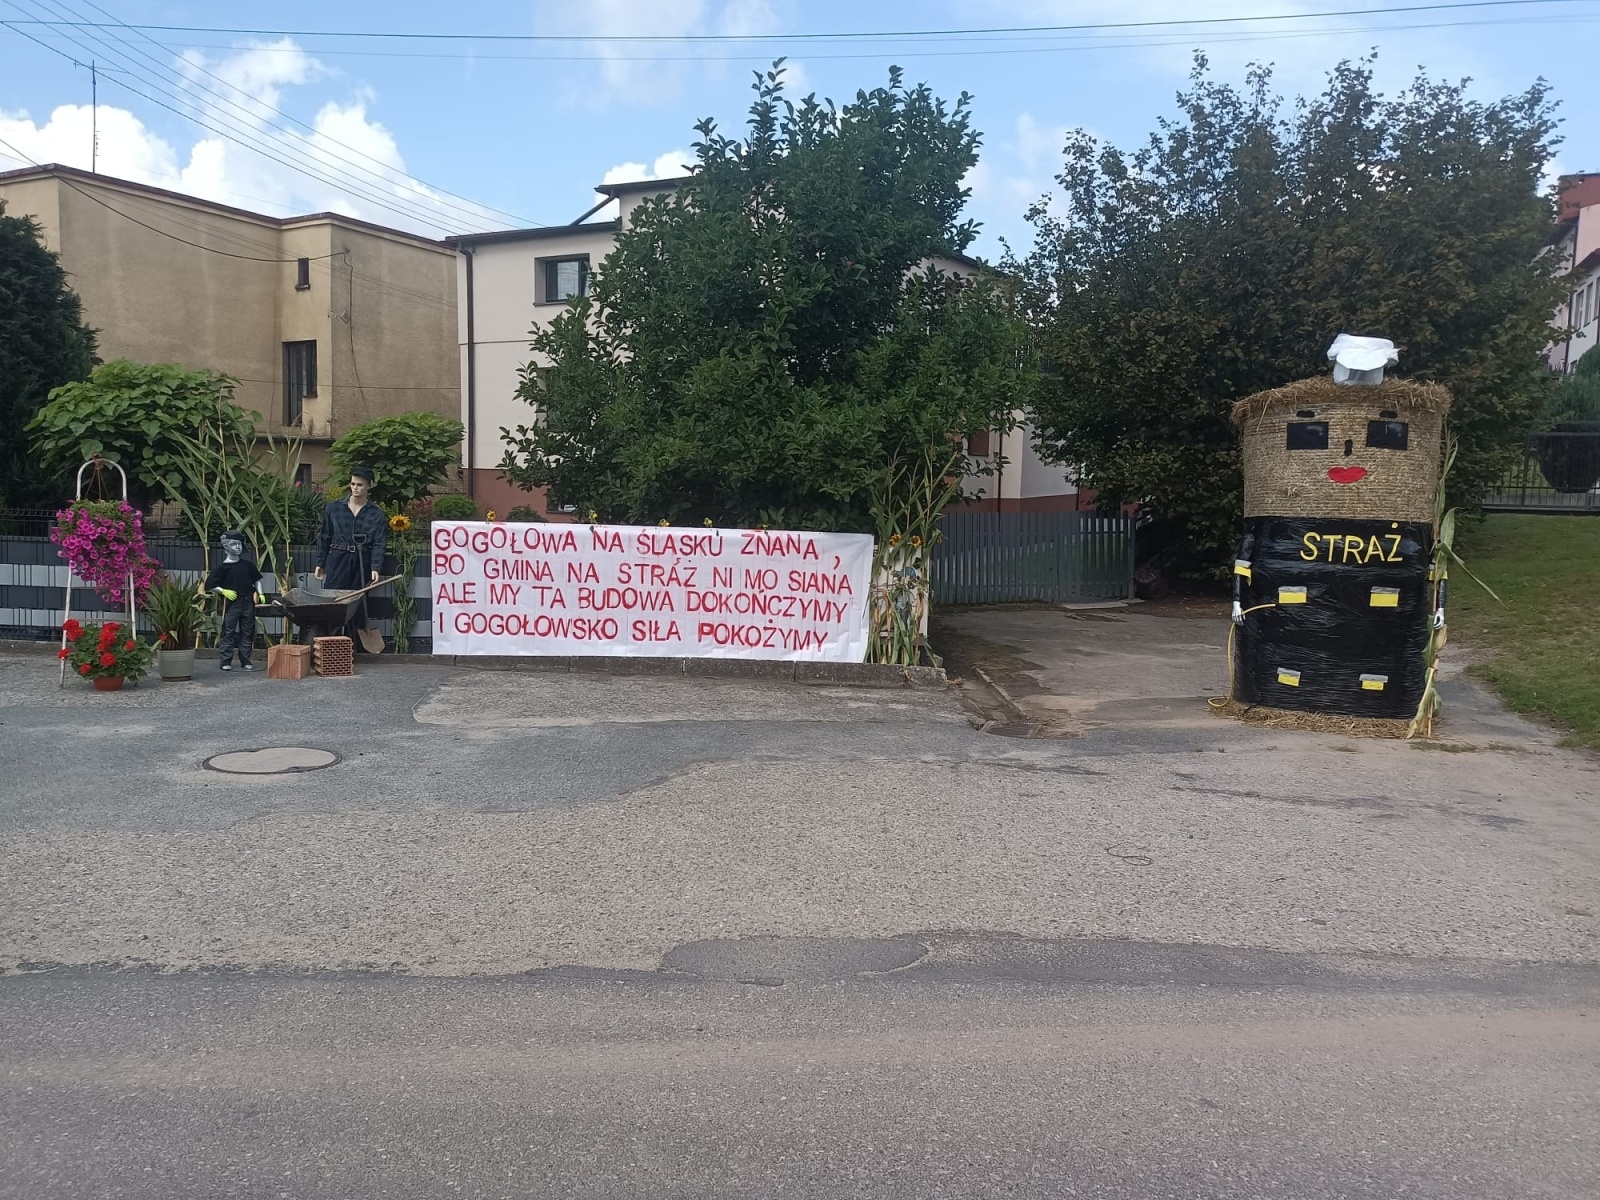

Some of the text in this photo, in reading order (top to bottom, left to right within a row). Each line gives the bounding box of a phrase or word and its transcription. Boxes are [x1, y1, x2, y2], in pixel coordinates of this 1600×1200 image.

[434, 526, 578, 554] GOGOŁOWA
[592, 530, 625, 553] NA
[1300, 522, 1404, 564] STRAŻ
[434, 553, 465, 576] BO
[483, 557, 554, 582] GMINA
[567, 562, 600, 584] NA
[713, 566, 733, 589] NI
[744, 568, 779, 591] MO
[787, 569, 853, 595] SIANA
[436, 582, 848, 624] ALE MY TA BUDOWA DOKOŃCZYMY
[438, 612, 829, 652] I GOGOŁOWSKO SIŁA POKOŻYMY
